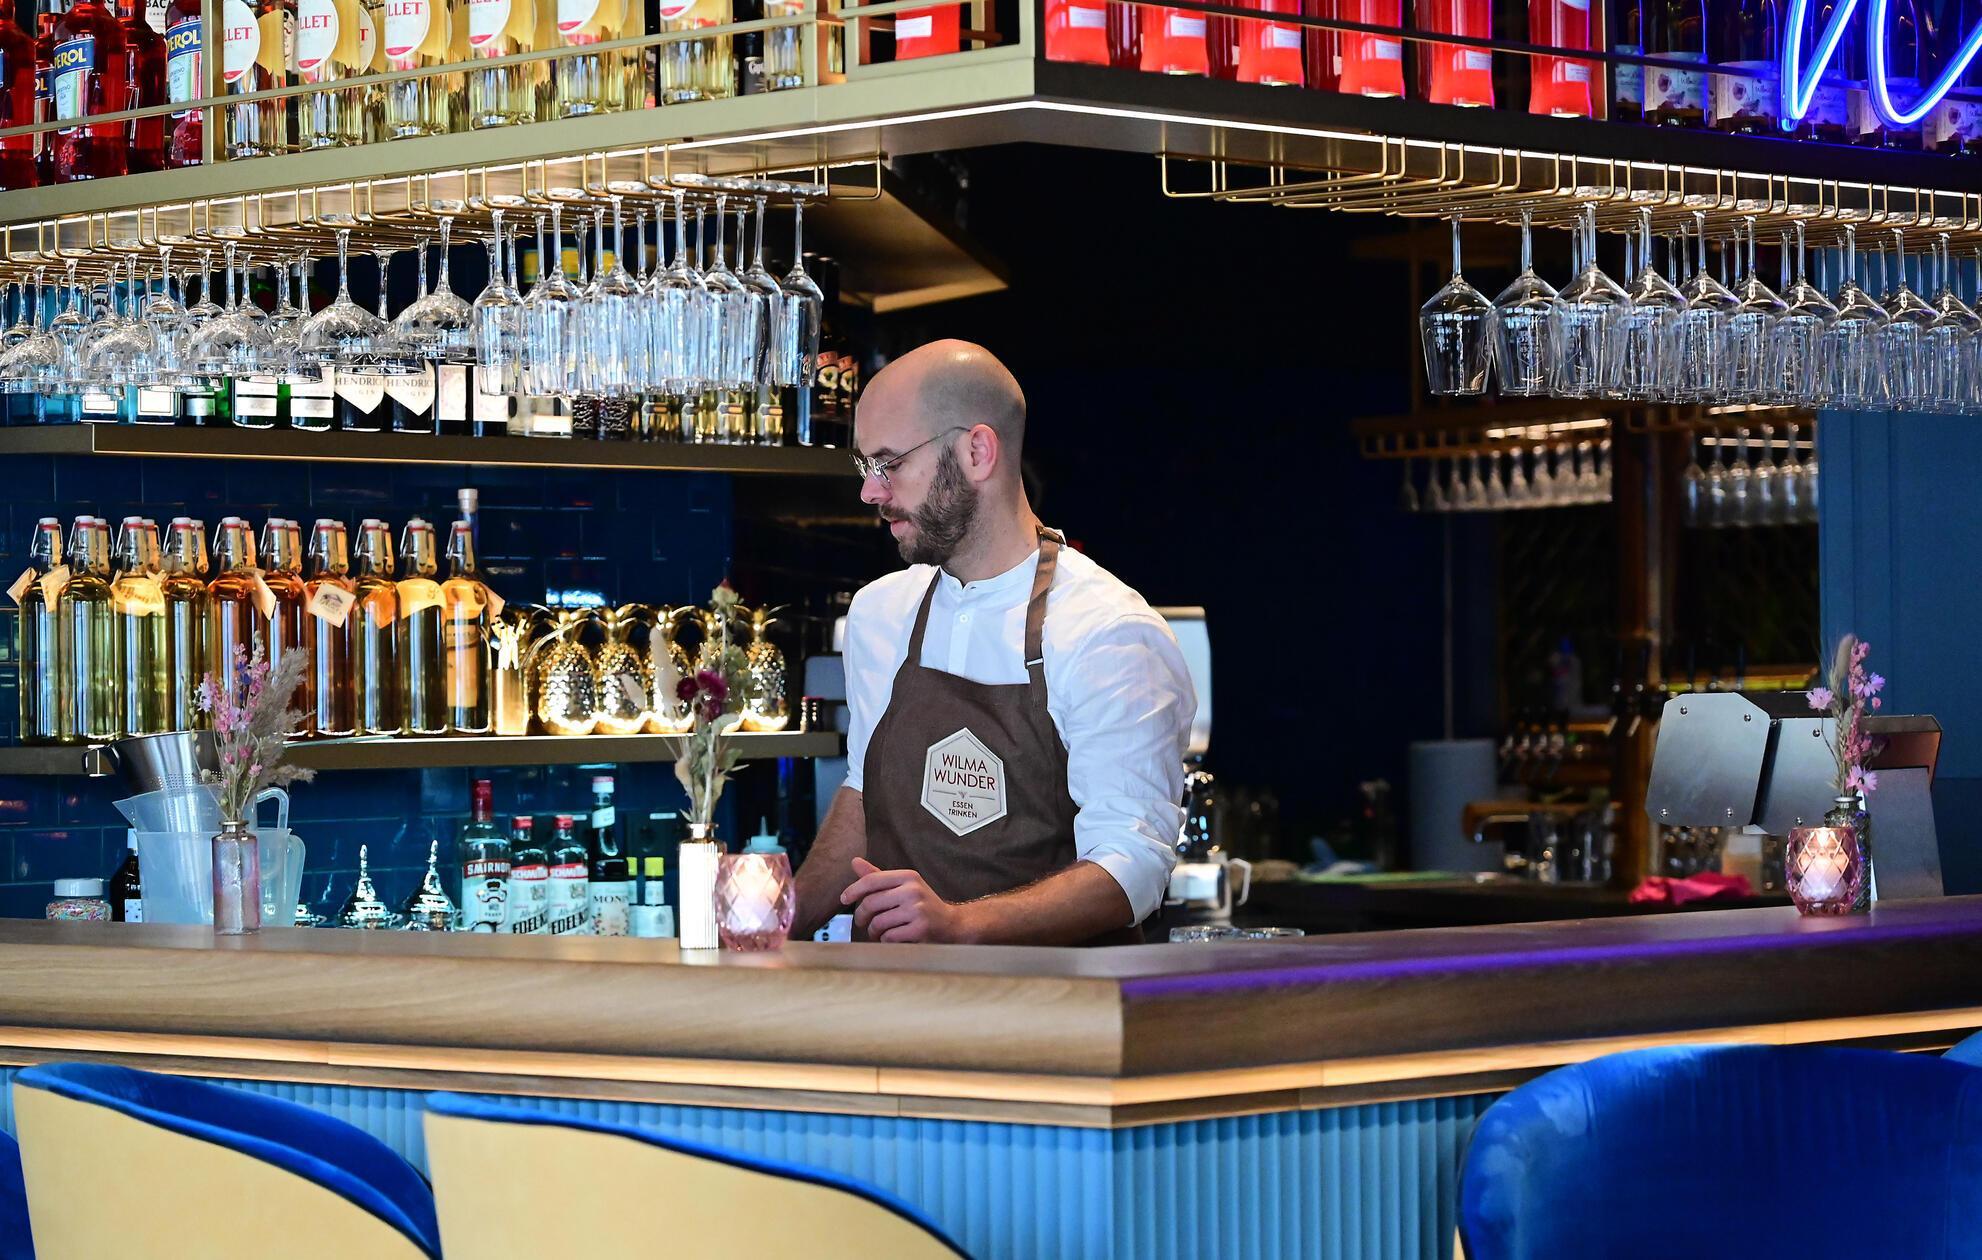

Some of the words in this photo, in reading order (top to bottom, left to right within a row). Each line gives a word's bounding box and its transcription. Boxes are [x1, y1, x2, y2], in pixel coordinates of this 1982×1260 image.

[942, 752, 988, 774] WILMA
[934, 767, 995, 791] WUNDER
[948, 807, 978, 819] TRINKEN
[952, 800, 974, 810] ESSEN
